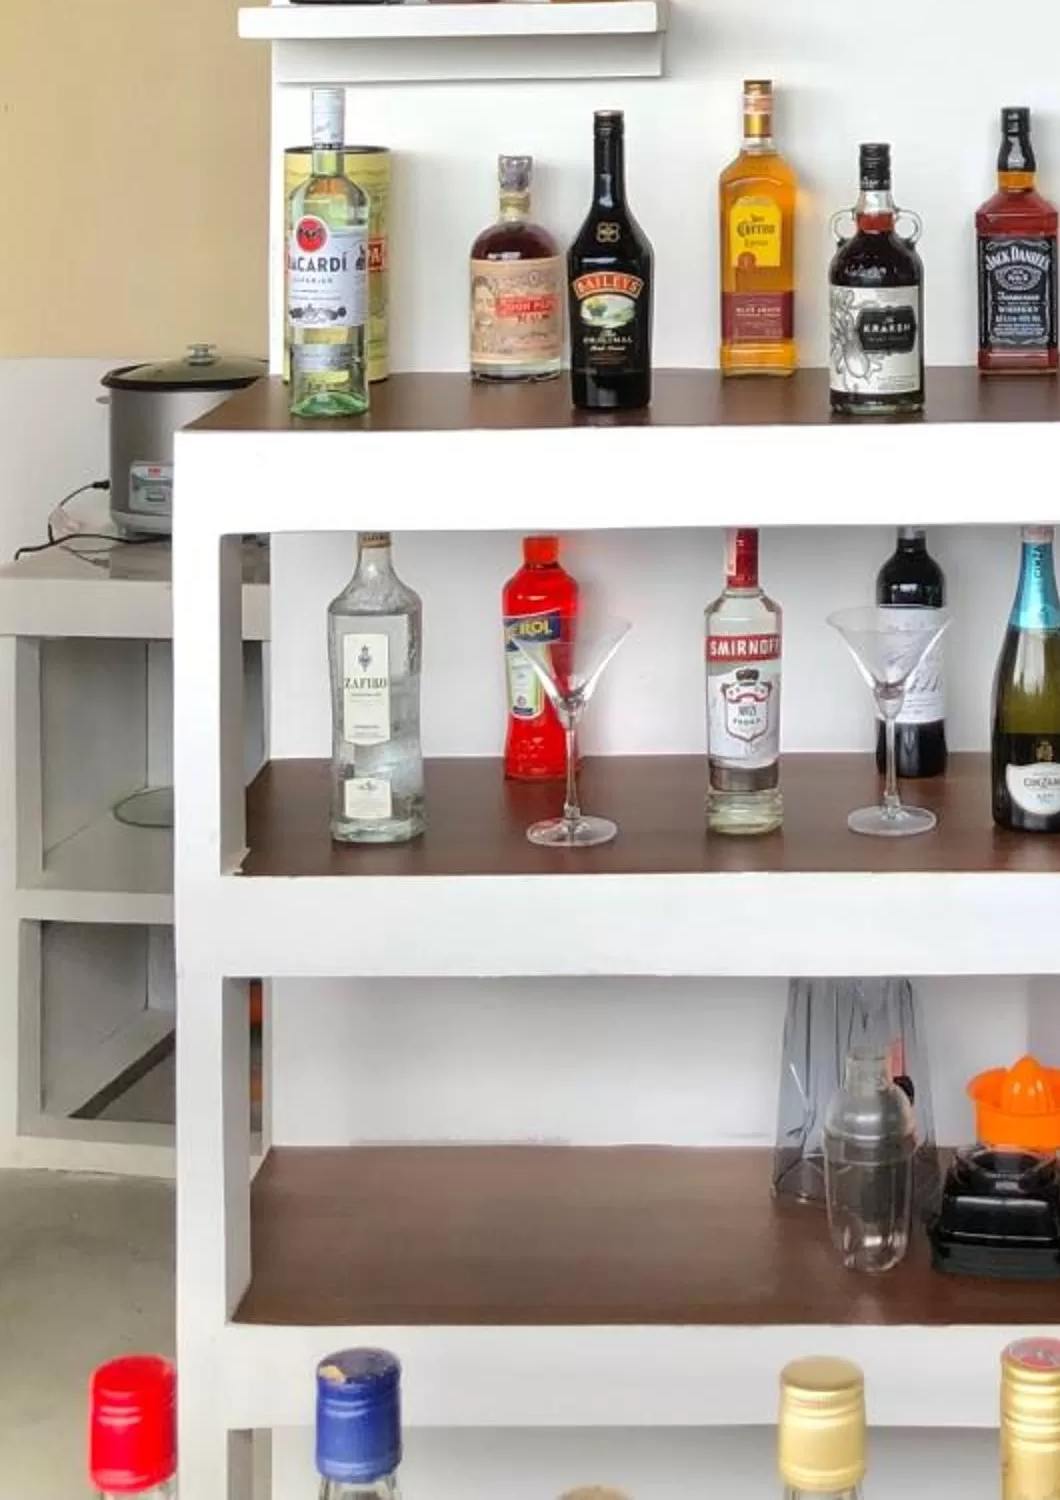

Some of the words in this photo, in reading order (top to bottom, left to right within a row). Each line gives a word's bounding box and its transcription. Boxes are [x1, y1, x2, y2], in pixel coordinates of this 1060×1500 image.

[986, 250, 1011, 271] JACK
[577, 275, 641, 294] BAILEYS
[863, 323, 911, 333] KRAKEN
